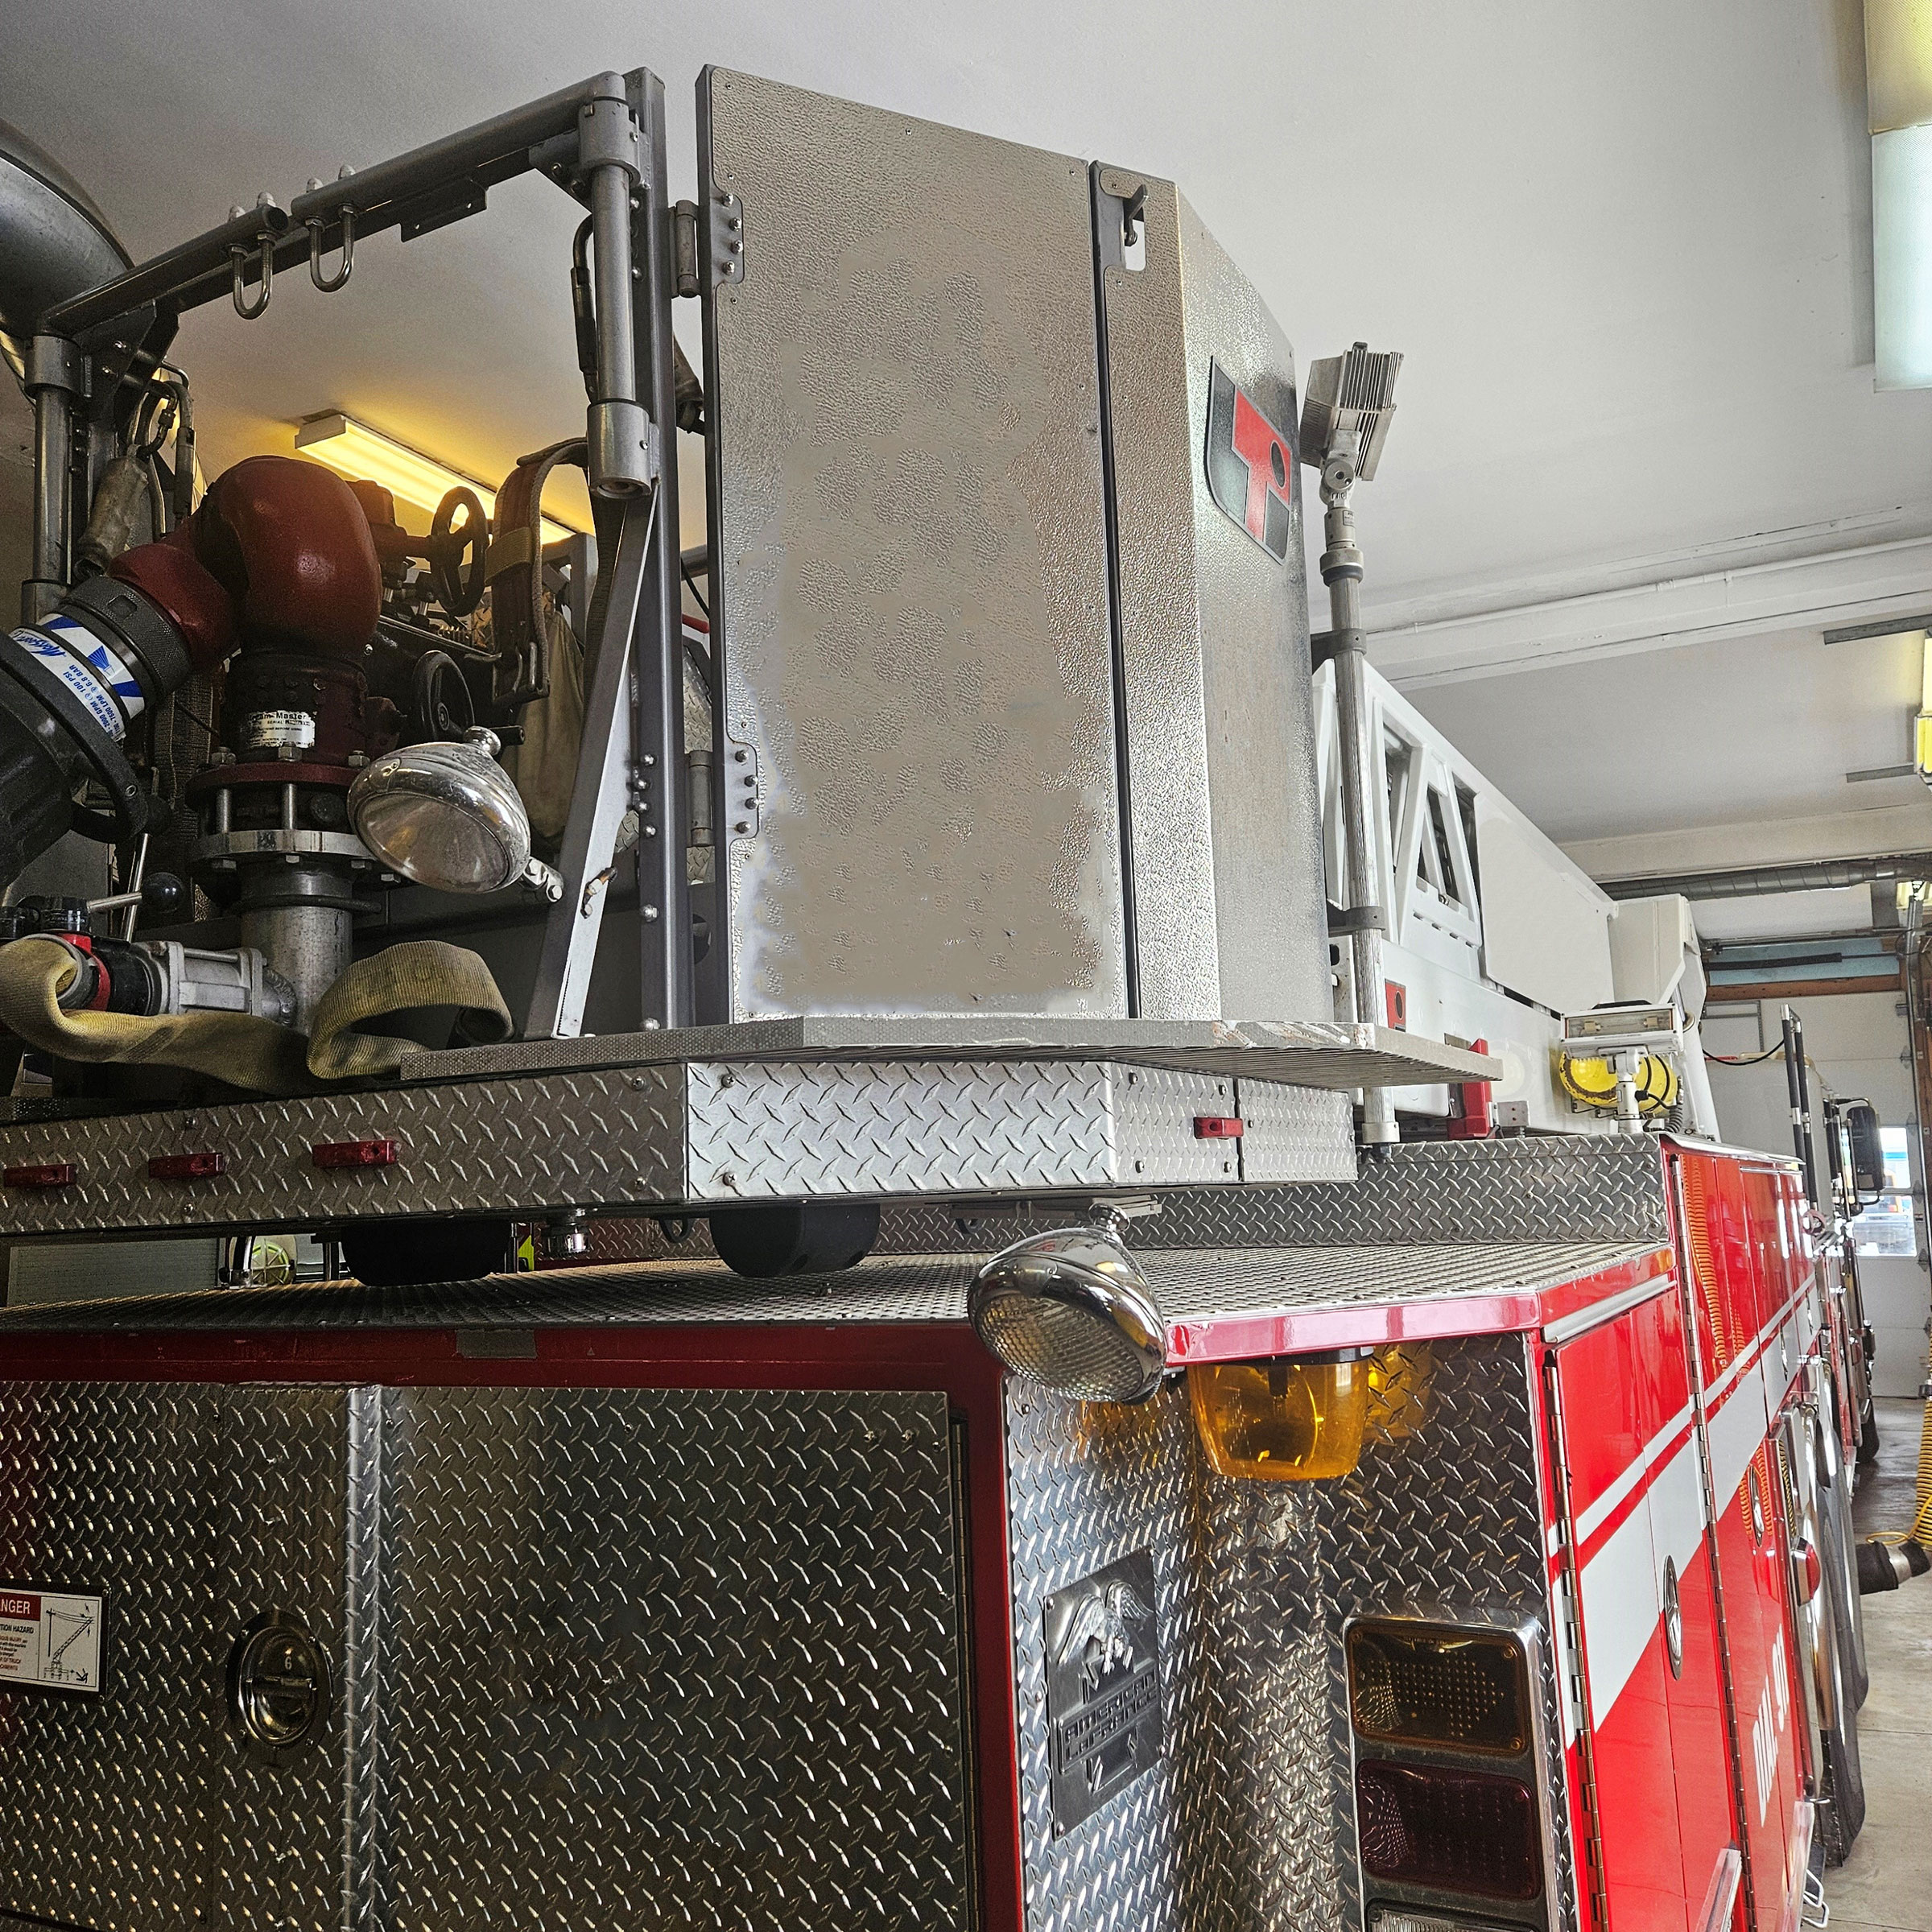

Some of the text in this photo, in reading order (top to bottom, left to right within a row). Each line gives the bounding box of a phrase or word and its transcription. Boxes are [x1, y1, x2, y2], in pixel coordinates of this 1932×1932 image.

[63, 671, 76, 682] PSI
[69, 664, 84, 678] BAR
[73, 681, 86, 693] 100
[81, 676, 93, 687] 6.8
[90, 701, 102, 715] GPM
[97, 694, 109, 708] LPM
[99, 714, 110, 728] 2000
[105, 707, 116, 721] 7600
[276, 712, 306, 720] Master
[0, 1598, 31, 1615] NGER
[12, 1624, 35, 1634] HAZARD
[284, 1656, 292, 1670] 6
[1773, 1623, 1790, 1732] 911
[1064, 1669, 1157, 1744] AMERICAN
